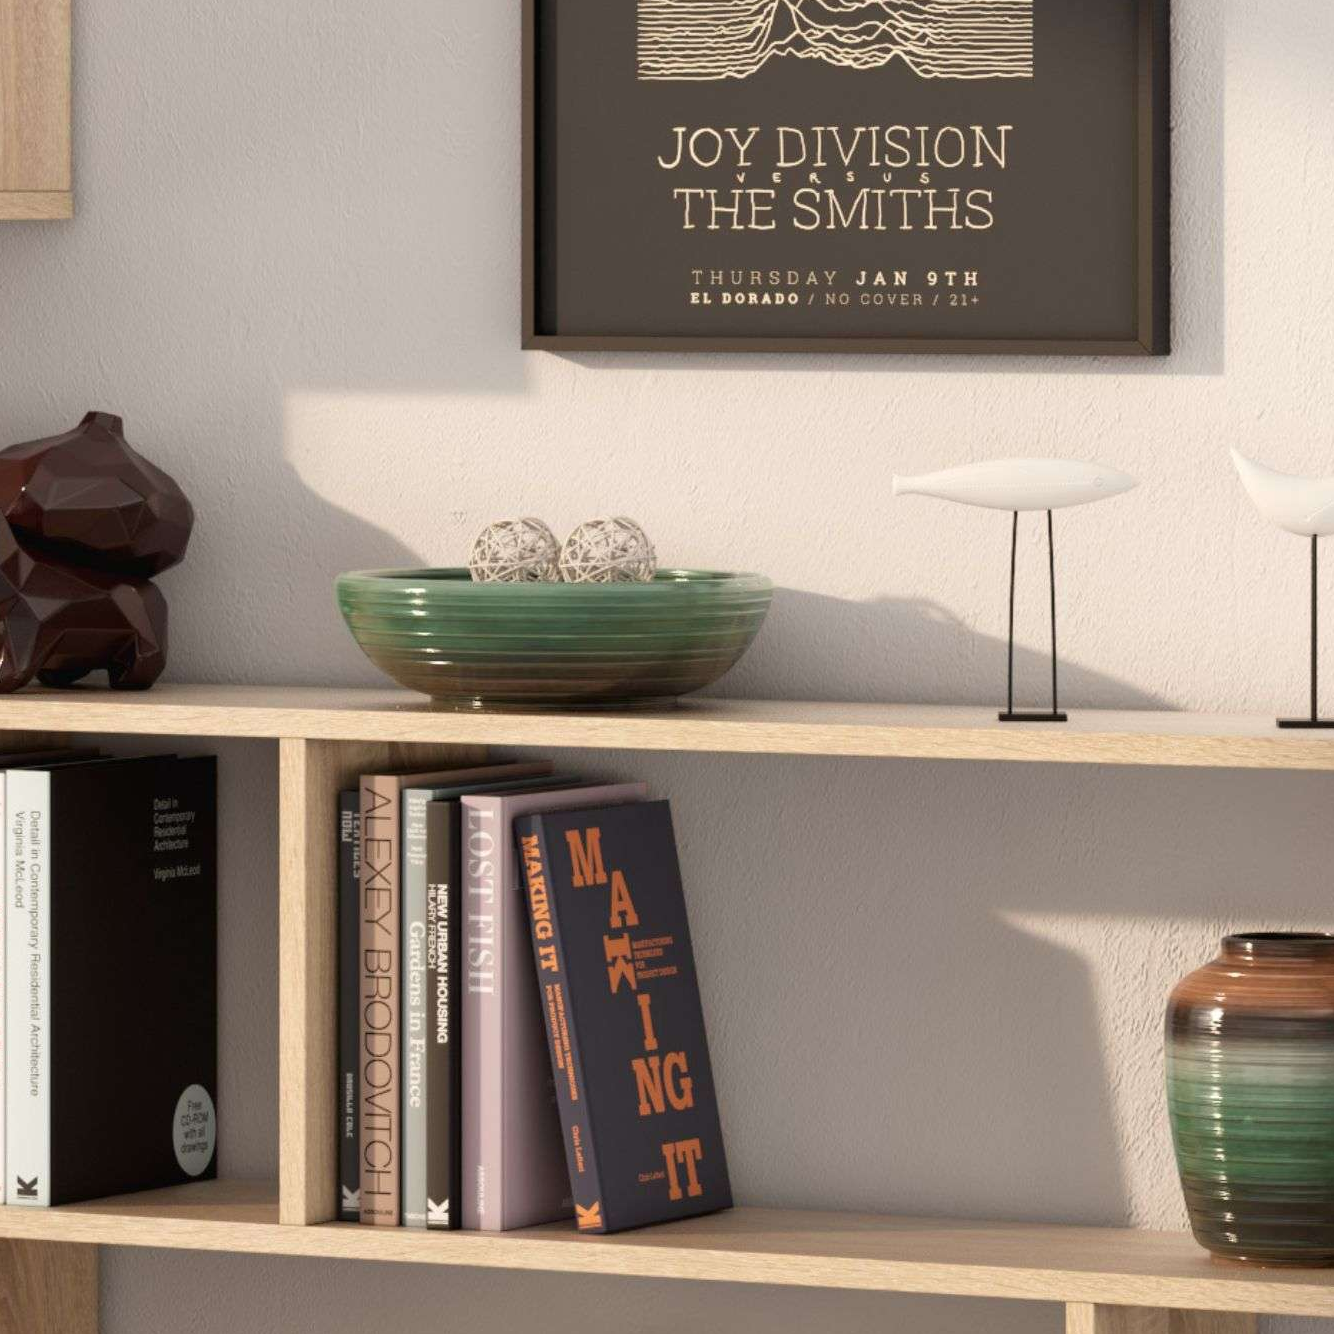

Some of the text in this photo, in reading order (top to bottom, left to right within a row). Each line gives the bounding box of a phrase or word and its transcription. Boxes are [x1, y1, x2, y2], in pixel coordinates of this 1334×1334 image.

[657, 125, 1014, 169] JOY DIVISION
[736, 171, 931, 184] VERSUS
[673, 187, 995, 230] THE SMITHS
[690, 292, 981, 307] EL DORADO NO COVER 21+
[691, 270, 980, 287] THURSDAY JAN 9TH
[12, 811, 25, 909] Virginia McLeod
[468, 810, 495, 995] LOST FISH
[521, 834, 559, 972] MAKING IT
[28, 811, 41, 1097] Detail in Contemporary Residential Architecture
[427, 883, 437, 969] HILARY FRENCH
[436, 883, 449, 1044] NEW URBAN HOUSING
[364, 786, 392, 1196] ALEXEY BRODOVITCH
[410, 921, 427, 1108] Gardens in France
[661, 1138, 703, 1201] IT
